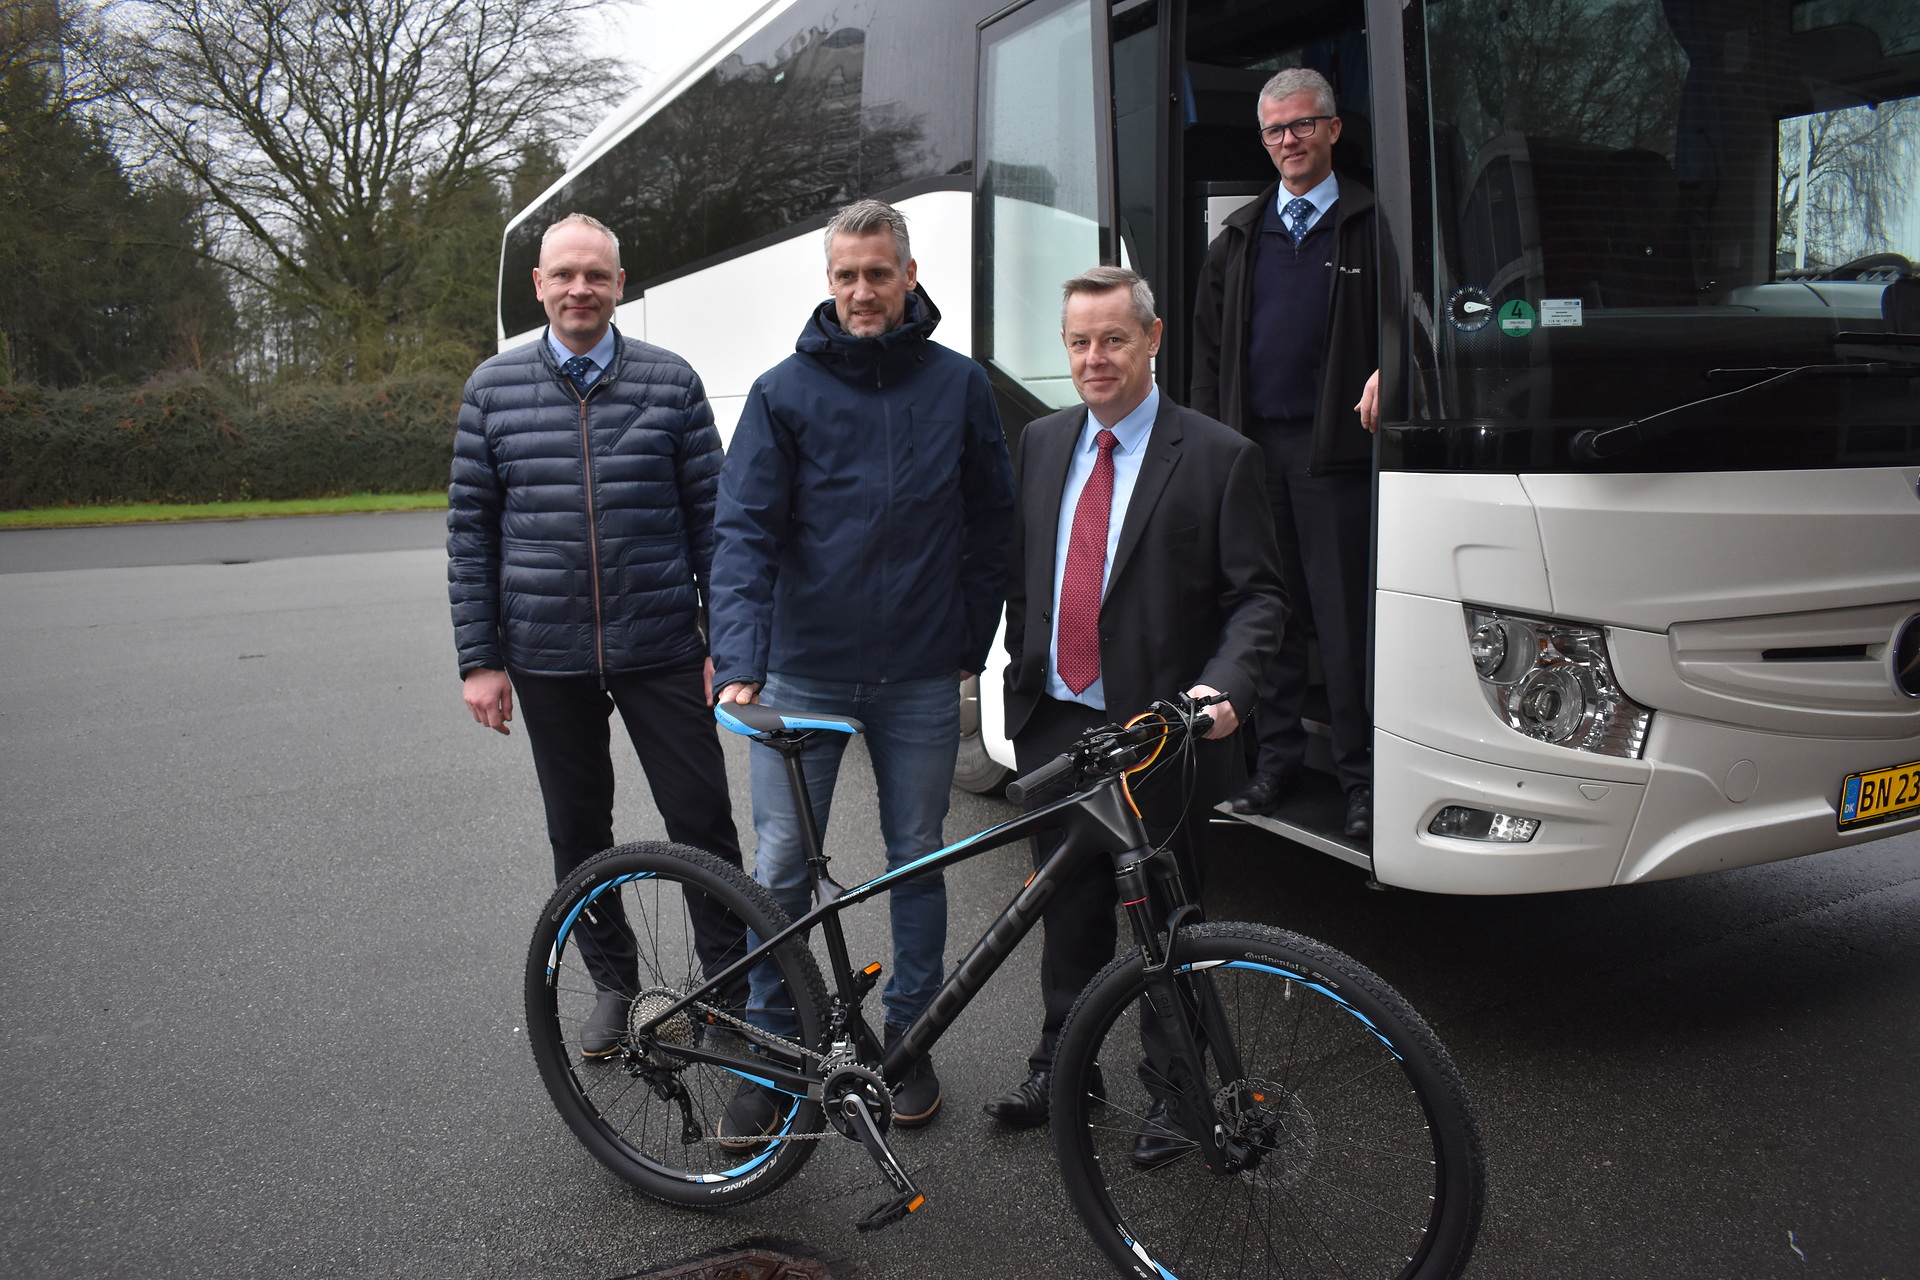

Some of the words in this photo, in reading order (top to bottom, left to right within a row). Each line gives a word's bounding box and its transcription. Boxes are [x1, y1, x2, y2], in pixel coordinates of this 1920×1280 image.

[1511, 300, 1523, 318] 4
[1860, 777, 1892, 812] BN
[1895, 771, 1920, 805] 23
[1844, 803, 1855, 814] DK
[904, 869, 1056, 1057] FOCUS
[1244, 951, 1299, 970] Continental
[879, 1160, 903, 1190] SLX
